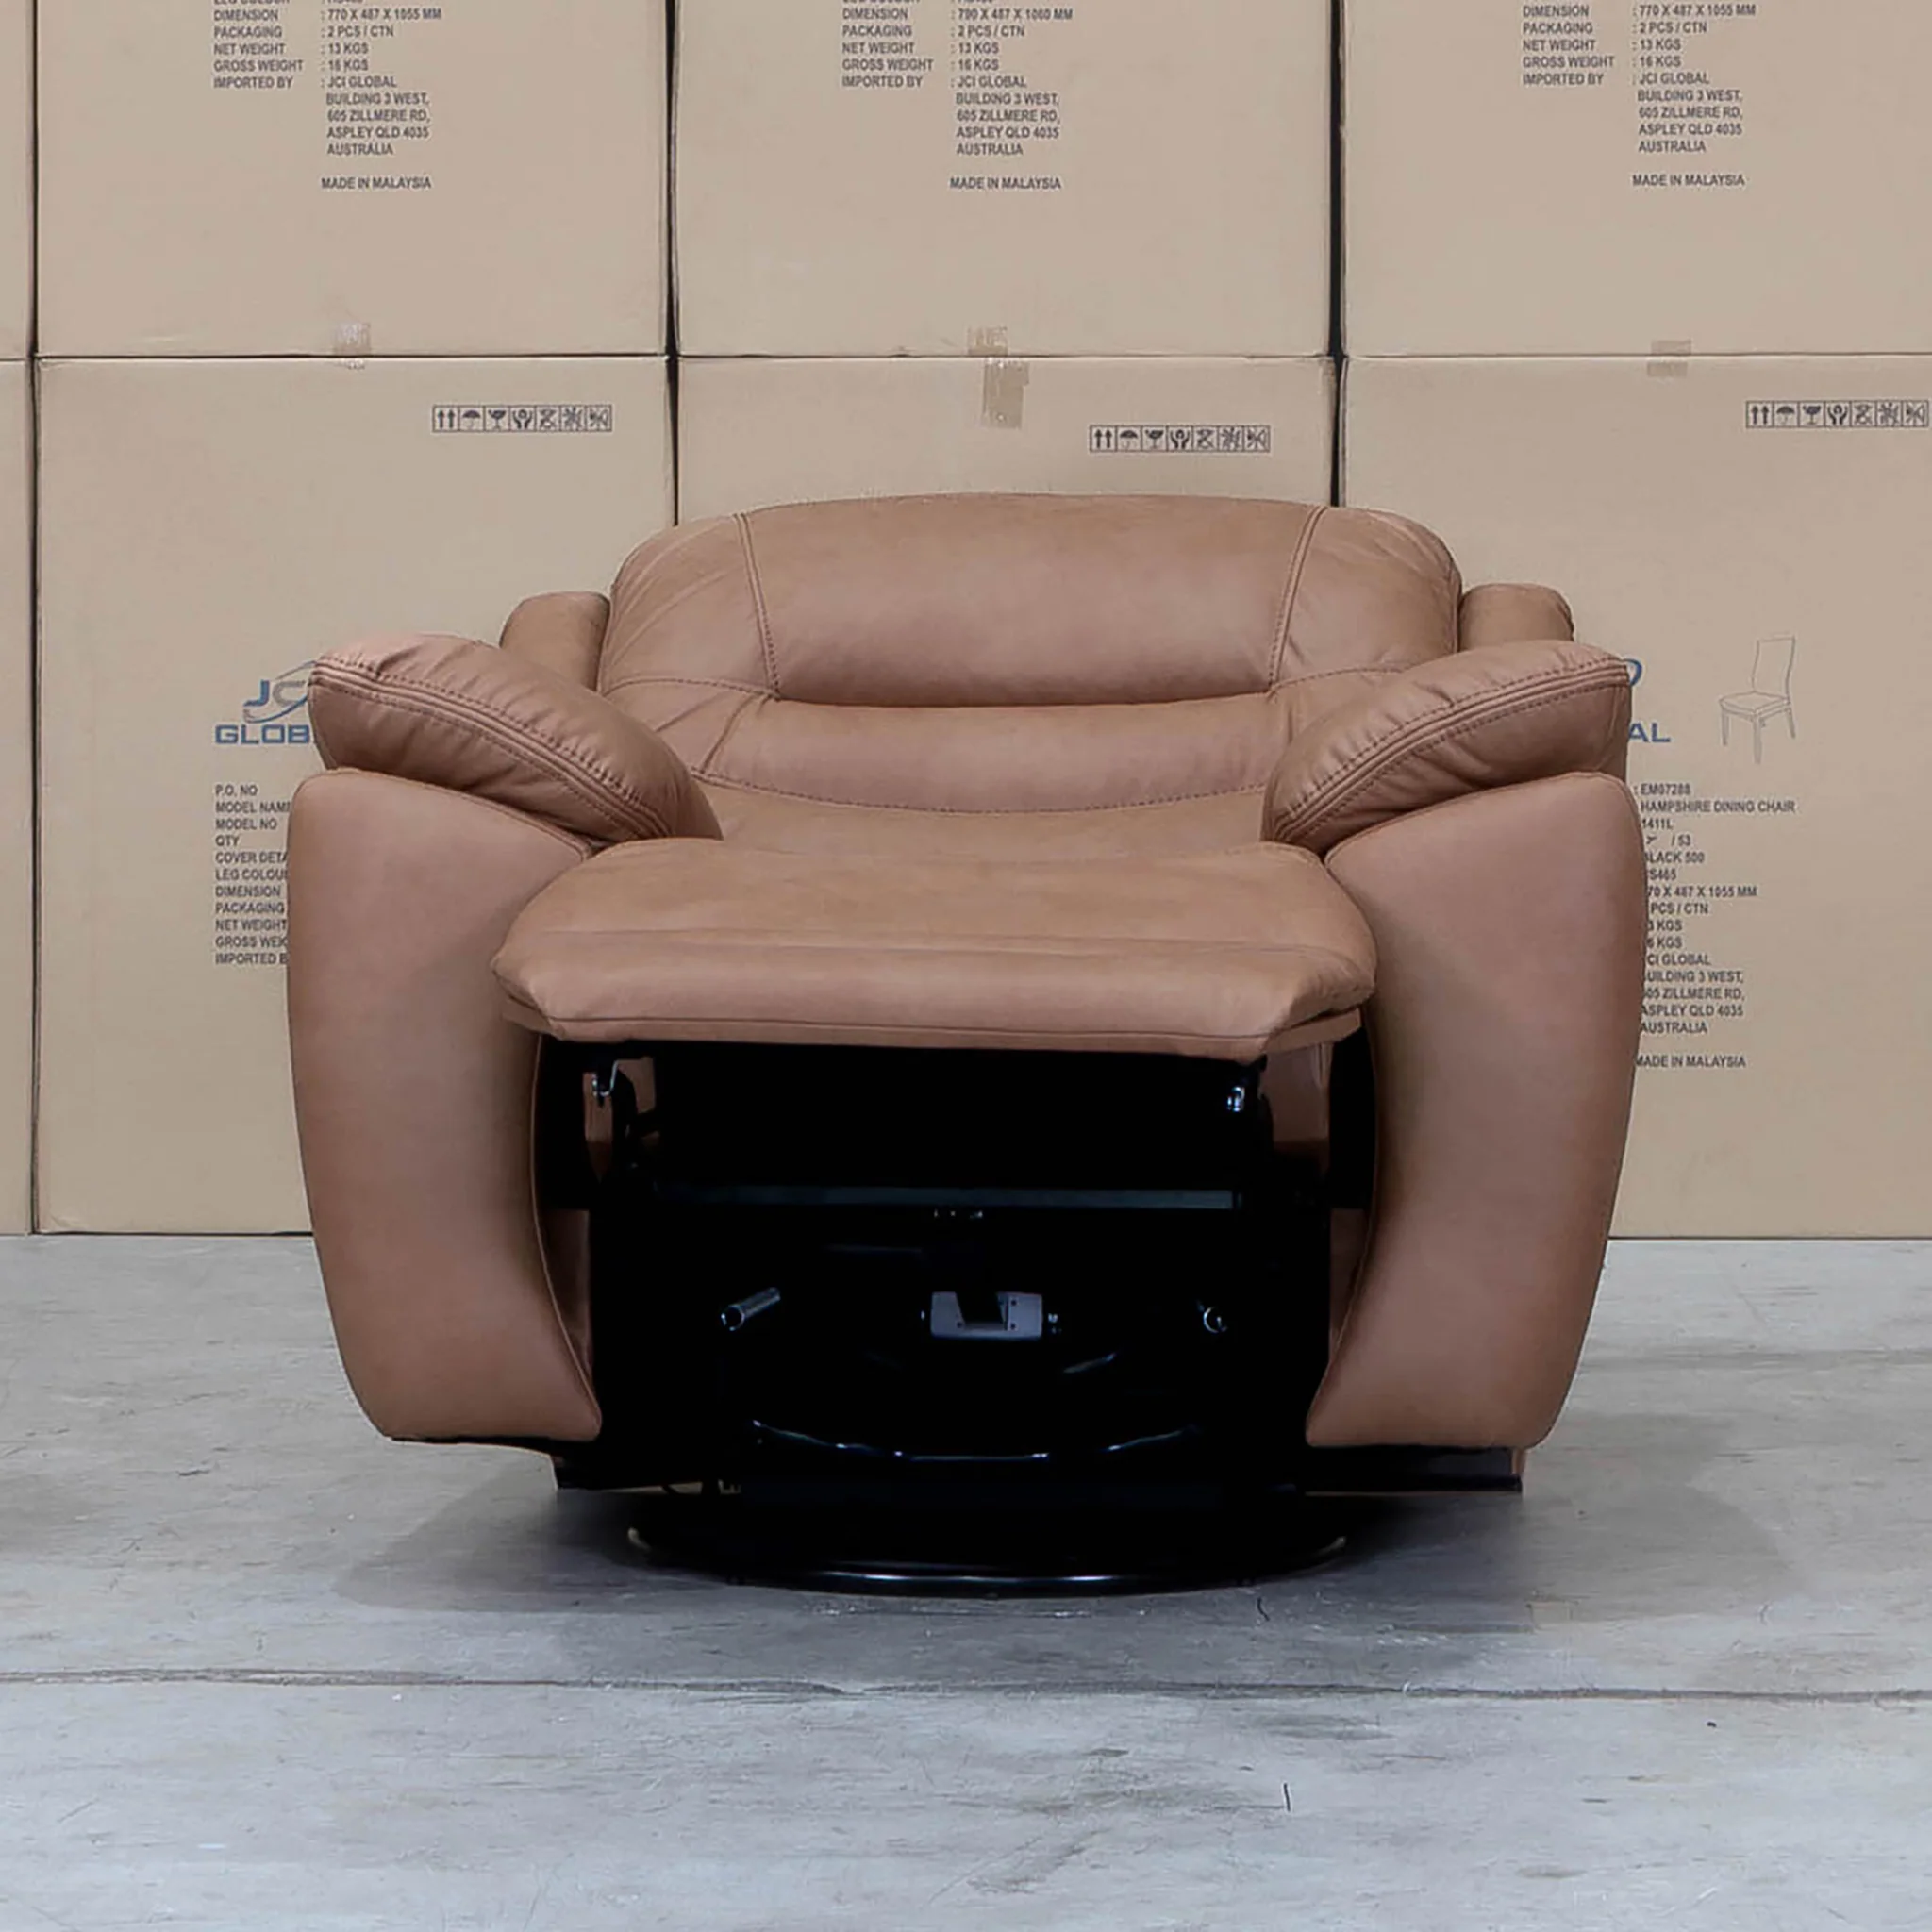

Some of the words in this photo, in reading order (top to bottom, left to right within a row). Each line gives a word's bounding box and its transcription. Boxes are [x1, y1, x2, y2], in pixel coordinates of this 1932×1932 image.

[213, 9, 278, 21] DIMENSION
[328, 8, 348, 20] 770
[423, 8, 441, 20] MM
[842, 8, 908, 20] DIMENSION
[1054, 8, 1073, 20] MM
[1524, 6, 1589, 17] DIMENSION
[1640, 5, 1659, 16] 770
[1707, 5, 1733, 16] 1055
[1736, 5, 1756, 16] MM
[213, 26, 282, 38] PACKAGING
[337, 26, 360, 37] PCS
[370, 26, 393, 37] CTN
[842, 25, 912, 37] PACKAGING
[968, 25, 991, 37] PCS
[1001, 25, 1024, 37] CTN
[1524, 23, 1592, 34] PACKAGING
[1649, 22, 1674, 33] PCS
[1683, 22, 1707, 33] CTN
[213, 43, 236, 55] NET
[239, 43, 286, 55] WEIGHT
[329, 43, 341, 54] 13
[344, 43, 368, 54] KGS
[842, 42, 866, 54] NET
[868, 42, 915, 54] WEIGHT
[958, 42, 971, 54] 13
[974, 42, 999, 54] KGS
[1524, 40, 1547, 50] NET
[1550, 40, 1595, 50] WEIGHT
[1641, 39, 1653, 50] 13
[1656, 39, 1681, 50] KGS
[213, 60, 255, 72] GROSS
[258, 60, 303, 72] WEIGHT
[344, 60, 368, 71] KGS
[842, 59, 884, 71] GROSS
[888, 59, 934, 71] WEIGHT
[958, 59, 971, 71] 16
[974, 59, 999, 71] KGS
[1524, 57, 1565, 67] GROSS
[1568, 57, 1614, 67] WEIGHT
[1641, 56, 1653, 67] 16
[1656, 56, 1681, 67] KGS
[213, 77, 275, 88] IMPORTED
[277, 77, 293, 88] BY
[327, 76, 346, 88] JCI
[348, 76, 396, 88] GLOBAL
[842, 76, 904, 87] IMPORTED
[907, 76, 923, 87] BY
[958, 76, 976, 88] JCI
[979, 76, 1026, 88] GLOBAL
[1524, 74, 1585, 85] IMPORTED
[1588, 74, 1604, 85] BY
[1640, 73, 1657, 84] JCI
[1660, 73, 1709, 84] GLOBAL
[326, 93, 380, 104] BUILDING
[956, 93, 1011, 104] BUILDING
[1638, 90, 1693, 101] BUILDING
[327, 110, 346, 122] 605
[350, 110, 407, 122] ZILLMERE
[957, 110, 976, 123] 605
[979, 110, 1037, 123] ZILLMERE
[1639, 108, 1658, 119] 605
[1661, 108, 1720, 119] ZILLMERE
[326, 127, 373, 138] ASPLEY
[375, 127, 400, 138] QLD
[403, 127, 428, 138] 4035
[957, 127, 1003, 138] ASPLEY
[1006, 127, 1029, 138] QLD
[1033, 127, 1058, 138] 4035
[1639, 124, 1685, 135] ASPLEY
[1688, 124, 1712, 135] QLD
[1716, 124, 1742, 135] 4035
[326, 143, 393, 156] AUSTRALIA
[957, 143, 1023, 156] AUSTRALIA
[1639, 142, 1706, 152] AUSTRALIA
[322, 177, 355, 189] MADE
[358, 177, 370, 189] IN
[373, 177, 431, 189] MALAYSIA
[950, 177, 984, 189] MADE
[987, 177, 998, 189] IN
[1002, 177, 1061, 189] MALAYSIA
[1633, 175, 1666, 186] MADE
[1670, 175, 1681, 186] IN
[1685, 175, 1744, 186] MALAYSIA
[243, 679, 307, 707] JC
[215, 724, 309, 743] GLOB
[241, 785, 258, 796] NO
[215, 802, 257, 813] MODEL
[1641, 802, 1711, 813] HAMPSHIRE
[1714, 802, 1756, 813] DINING
[1758, 802, 1794, 813] CHAIR
[215, 819, 257, 829] MODEL
[260, 819, 276, 829] NO
[215, 836, 240, 846] QTY
[215, 852, 257, 863] COVER
[1685, 852, 1705, 863] 500
[215, 869, 239, 880] LEG
[215, 886, 281, 896] DIMENSION
[1675, 887, 1693, 896] 487
[1709, 887, 1734, 896] 1055
[1738, 887, 1757, 896] MM
[215, 903, 284, 914] PACKAGING
[1651, 904, 1674, 914] PCS
[1684, 904, 1708, 914] CTN
[215, 920, 238, 931] NET
[242, 920, 287, 931] WEIGHT
[1657, 921, 1682, 931] KGS
[215, 937, 257, 947] GROSS
[1657, 938, 1682, 948] KGS
[215, 954, 276, 964] IMPORTED
[1662, 954, 1710, 965] GLOBAL
[1647, 972, 1694, 982] UILDING
[1662, 989, 1722, 999] ZILLMERE
[1690, 1006, 1714, 1016] QLD
[1717, 1006, 1742, 1016] 4035
[1641, 1022, 1707, 1033] AUSTRALIA
[1636, 1056, 1667, 1067] MADE
[1672, 1056, 1682, 1067] IN
[1686, 1056, 1745, 1067] MALAYSIA
